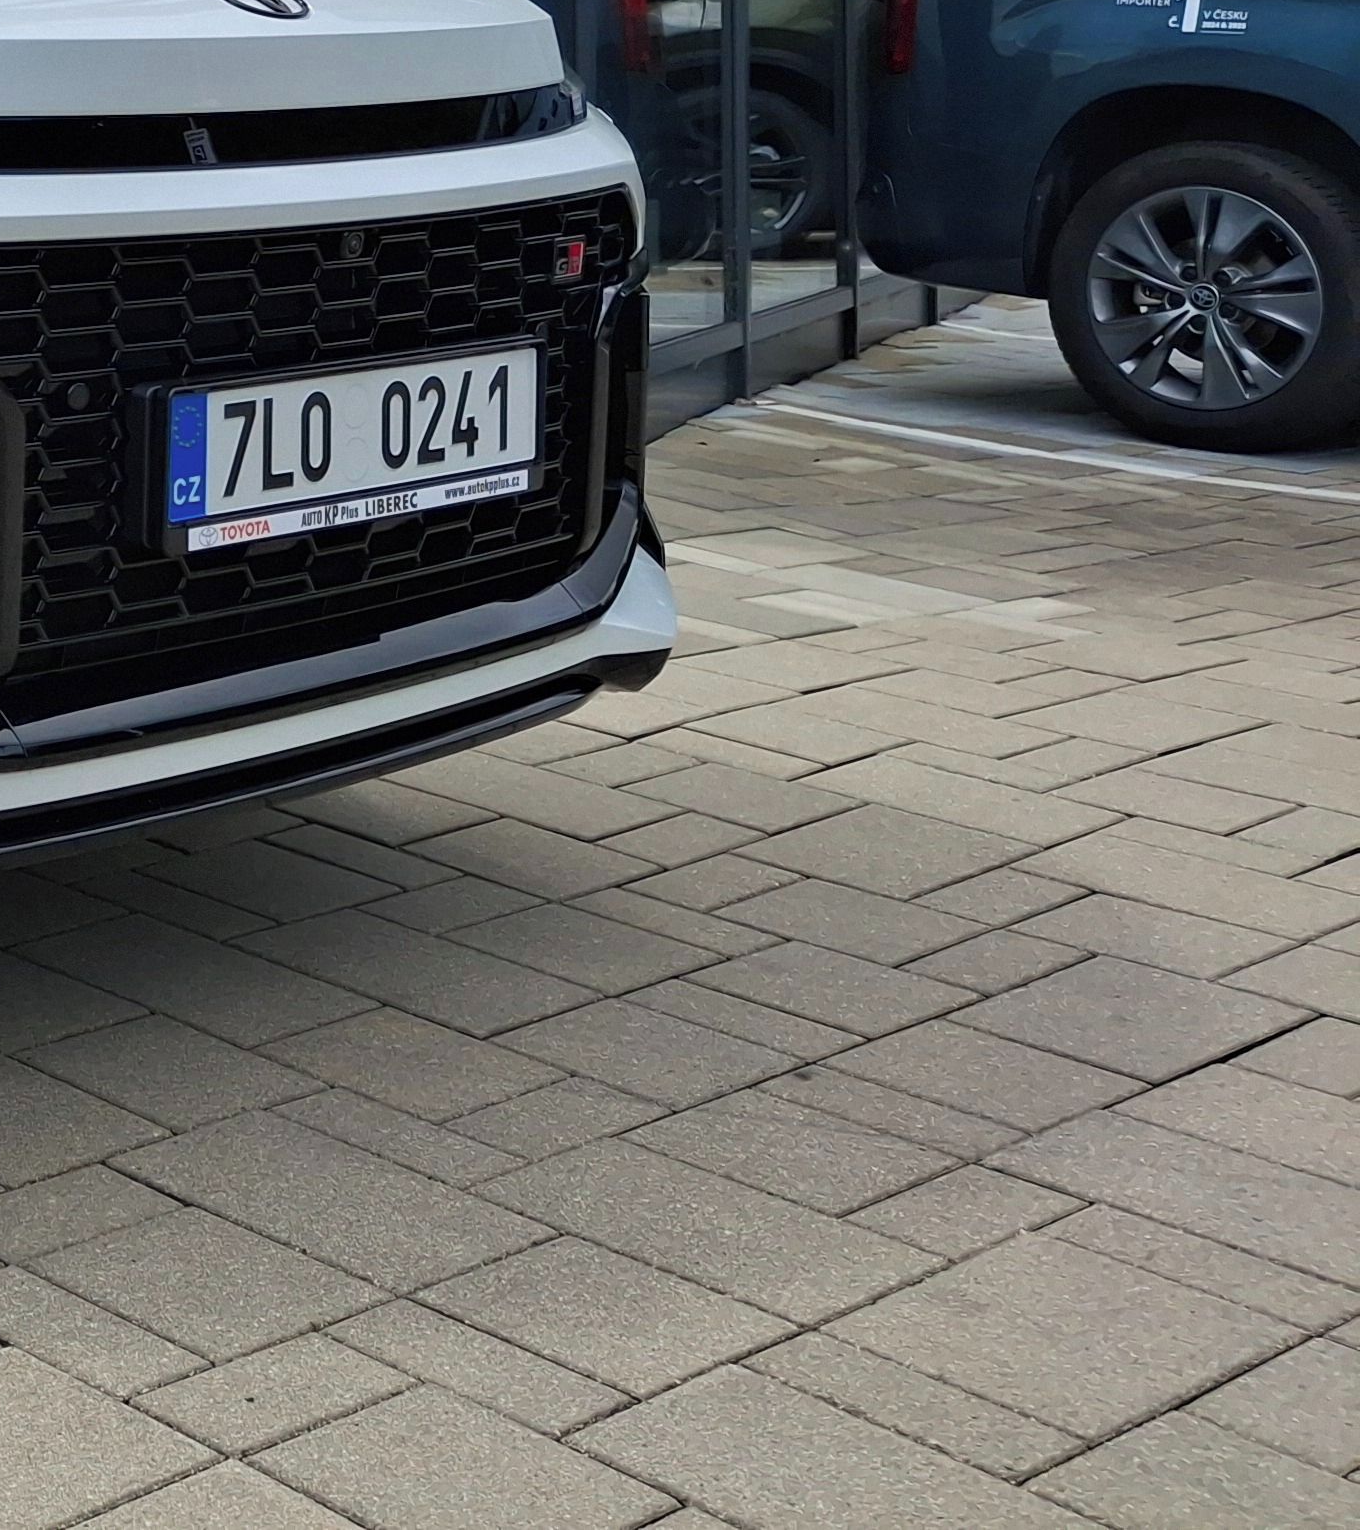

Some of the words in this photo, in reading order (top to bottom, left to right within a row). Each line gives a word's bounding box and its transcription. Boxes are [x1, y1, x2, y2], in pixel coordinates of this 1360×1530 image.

[1203, 10, 1212, 20] V
[1213, 8, 1248, 21] ČESKU
[381, 364, 509, 471] 0241
[173, 475, 201, 505] CZ
[220, 519, 271, 542] TOYOTA
[301, 512, 322, 527] AUTO
[324, 505, 339, 526] KP
[341, 507, 359, 520] Plus
[365, 492, 418, 517] LIBEREC
[444, 476, 520, 500] www.autokpplus.cz
